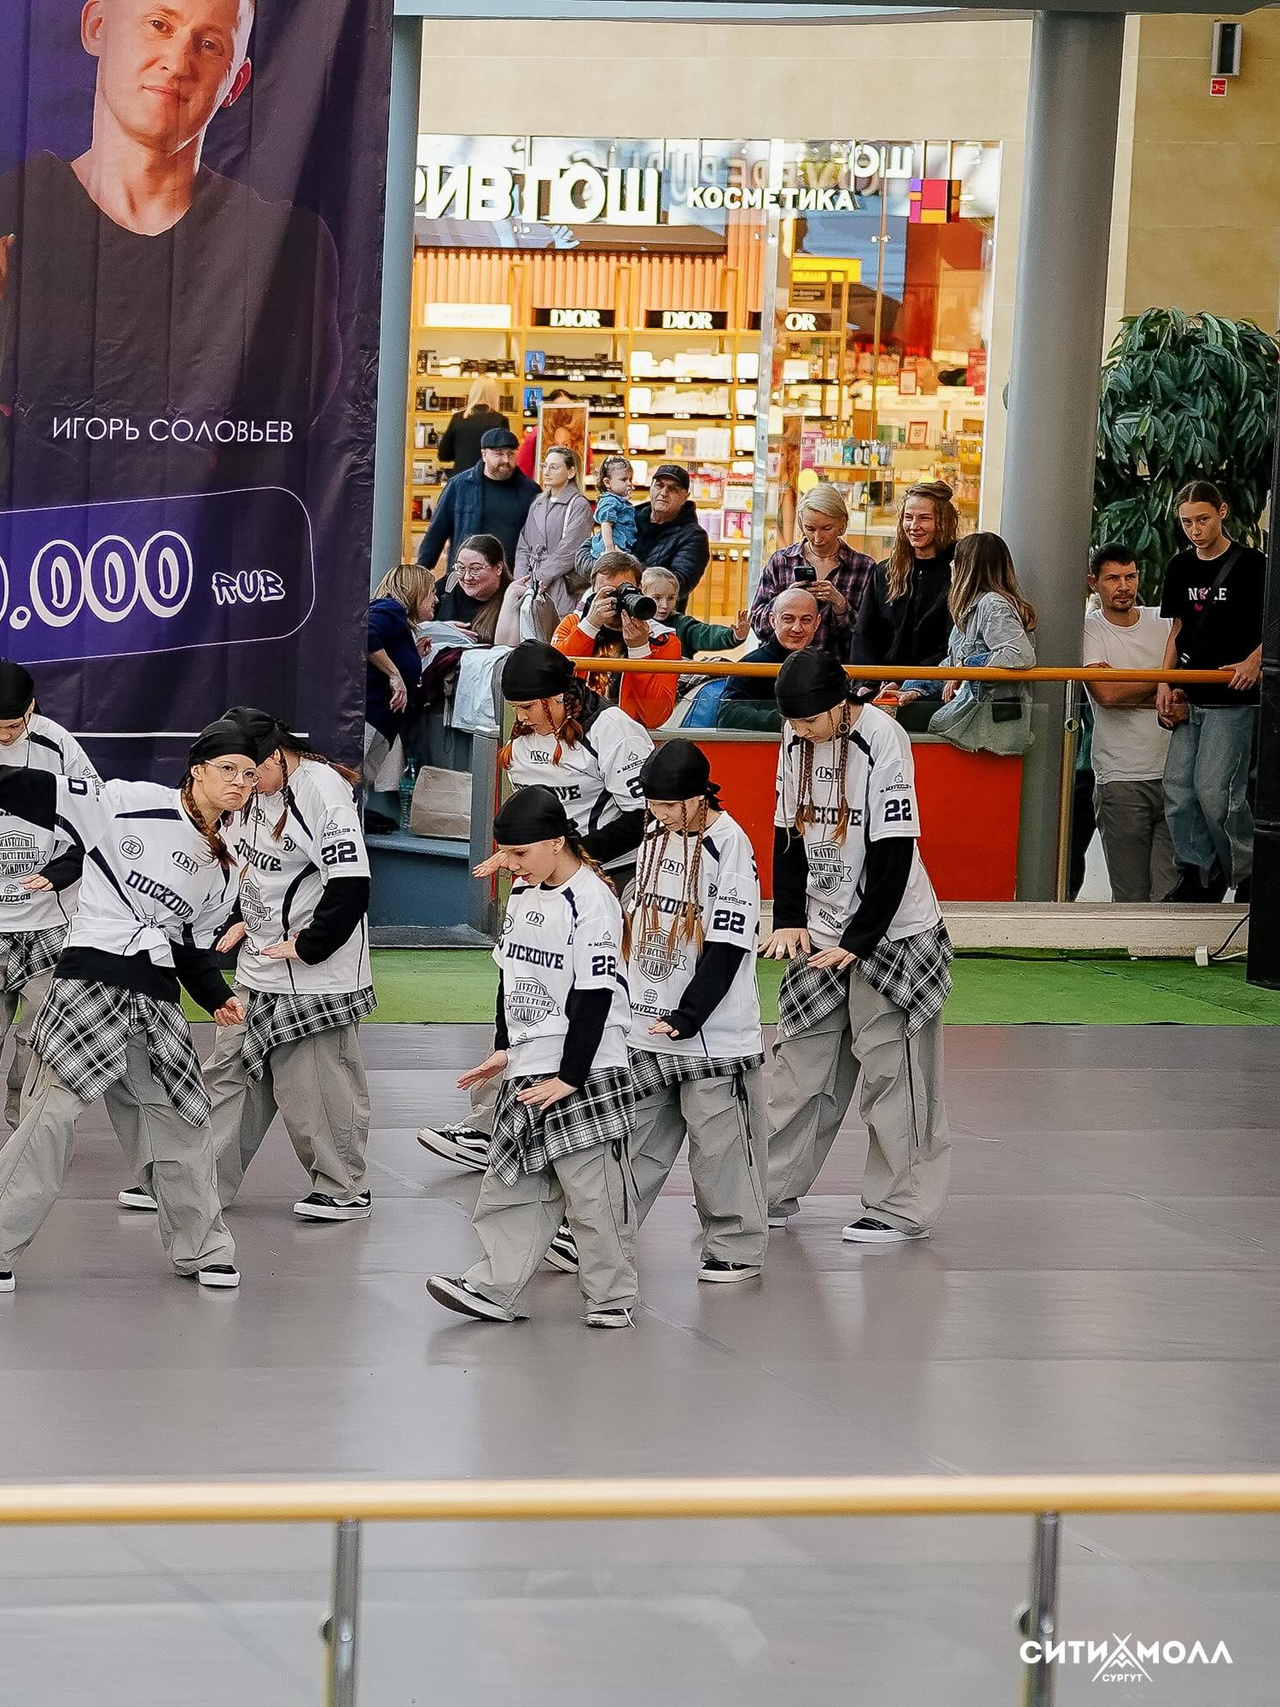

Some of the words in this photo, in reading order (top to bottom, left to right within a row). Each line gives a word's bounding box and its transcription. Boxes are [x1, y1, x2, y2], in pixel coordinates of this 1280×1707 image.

[415, 164, 514, 221] ИВ
[522, 161, 663, 225] ГОШ
[687, 186, 856, 211] КОСМЕТИКА
[549, 309, 601, 328] DIOR
[662, 311, 714, 330] DIOR
[784, 313, 817, 332] OR
[53, 417, 140, 440] ИГОРЬ
[149, 419, 293, 443] СОЛОВЬЕВ
[212, 569, 286, 604] RUB
[884, 799, 912, 822] 22
[321, 841, 358, 866] 22
[125, 869, 195, 920] DUCKDIVE
[713, 909, 746, 935] 22
[592, 955, 617, 977] 22
